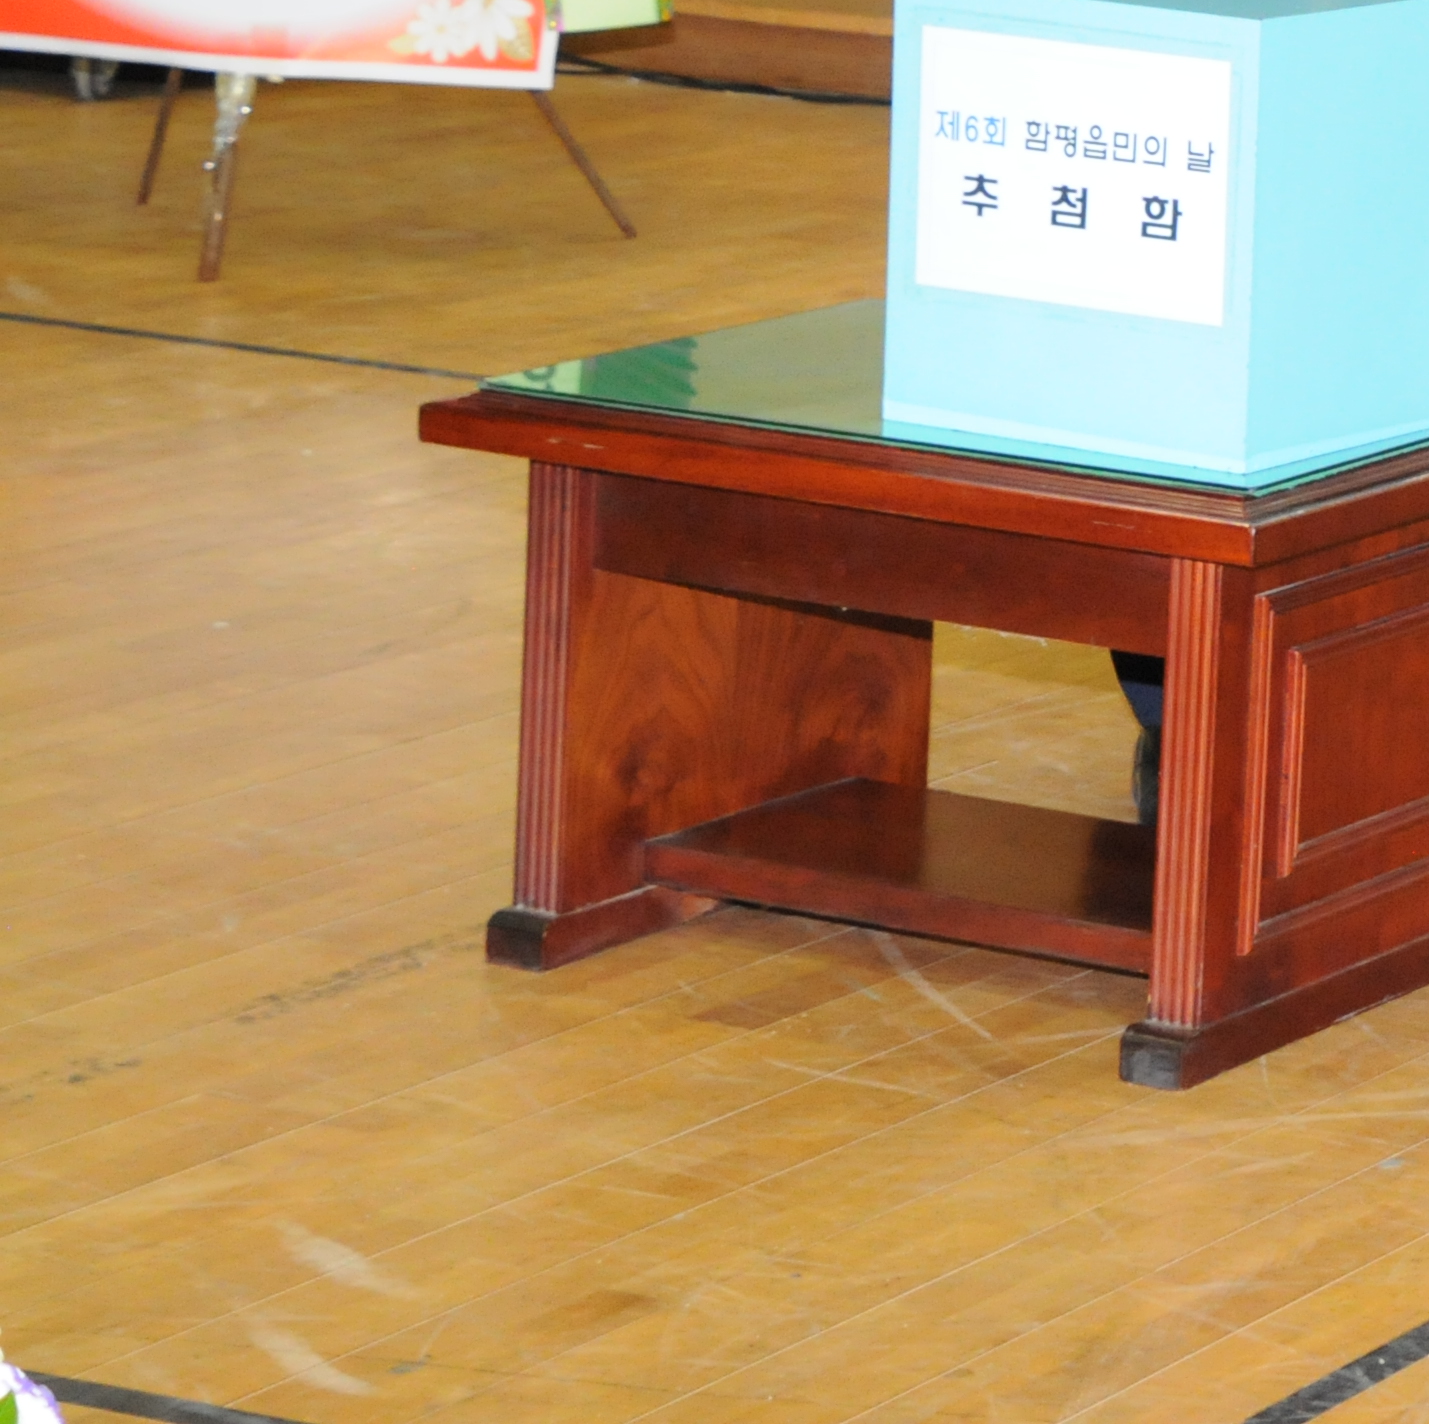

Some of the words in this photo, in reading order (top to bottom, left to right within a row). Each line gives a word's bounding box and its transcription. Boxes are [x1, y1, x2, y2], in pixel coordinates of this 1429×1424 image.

[935, 110, 1006, 147] 제6회
[1025, 119, 1167, 168] 함평읍민의
[1187, 140, 1214, 173] 날
